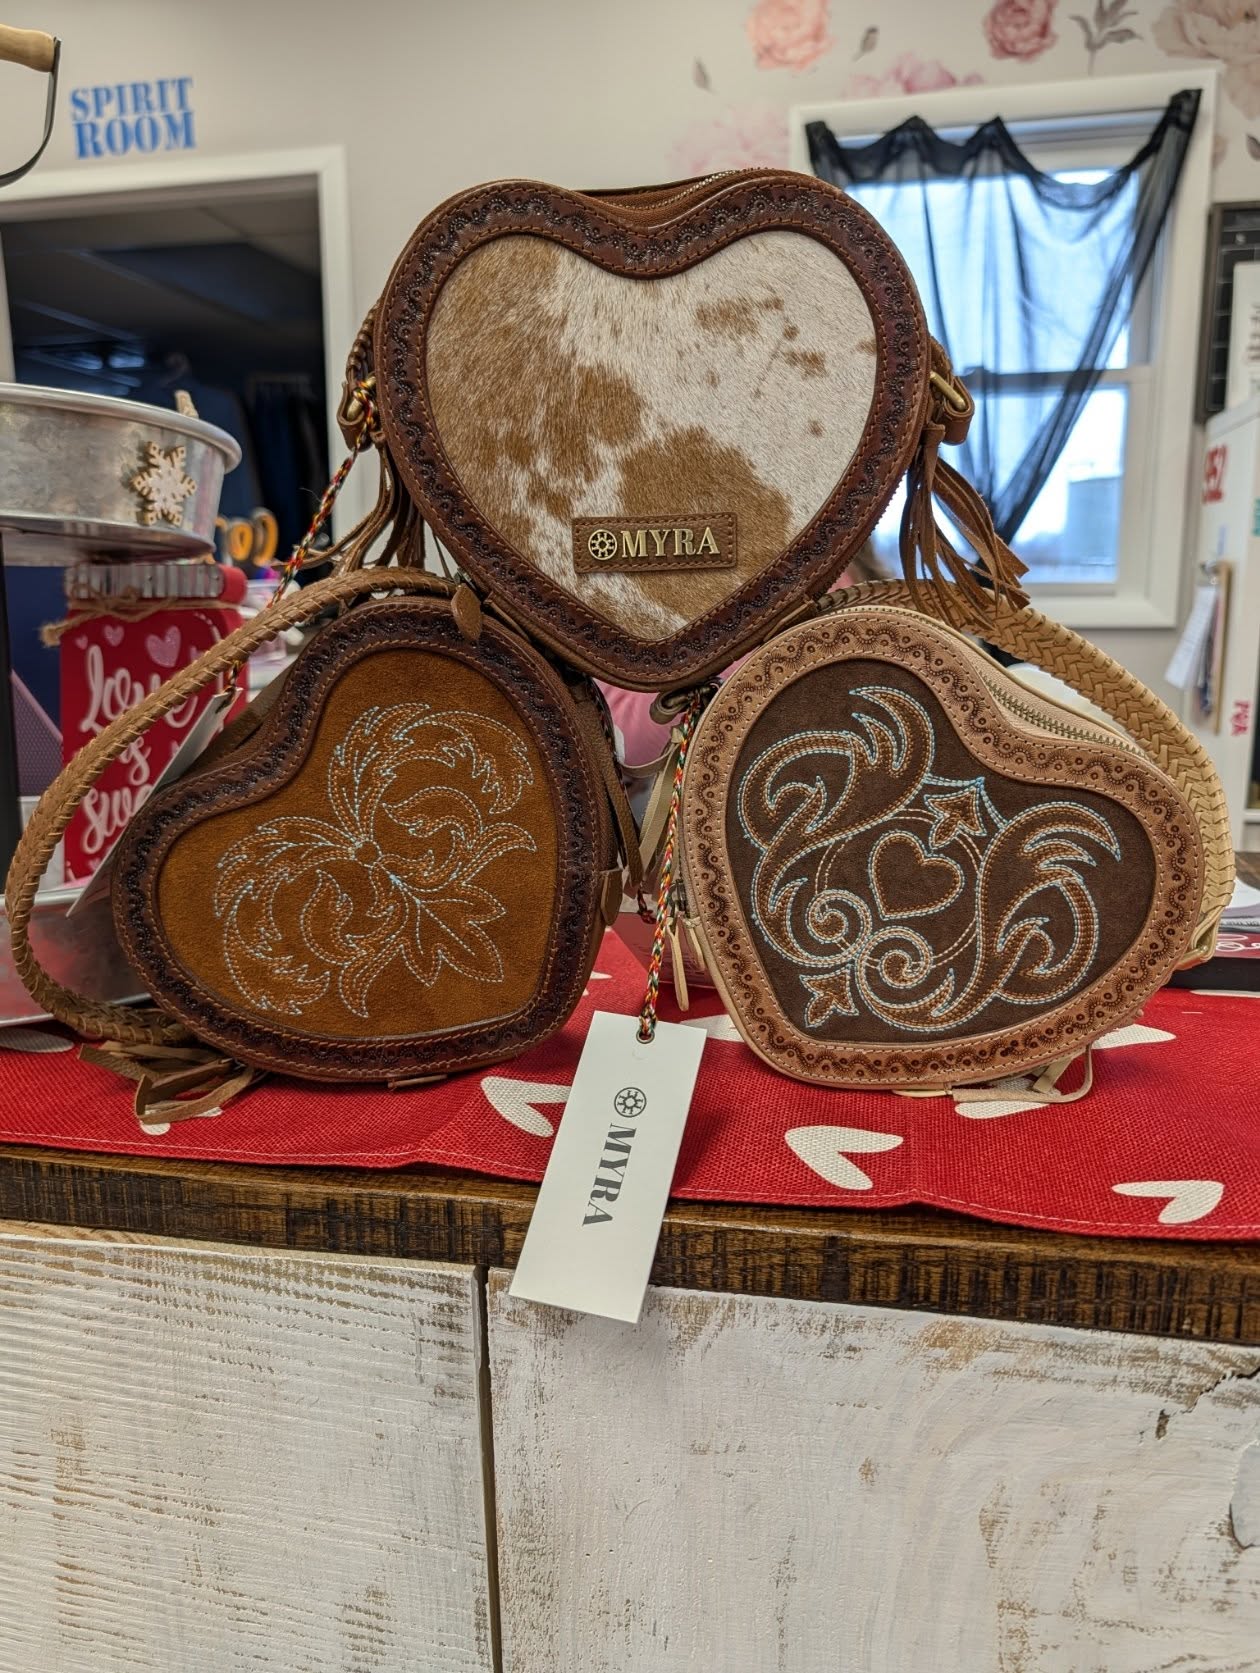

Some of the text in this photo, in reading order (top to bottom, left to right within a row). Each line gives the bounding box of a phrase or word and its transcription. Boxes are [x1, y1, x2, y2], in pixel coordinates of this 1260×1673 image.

[70, 77, 194, 121] SPIRIT
[73, 111, 197, 159] ROOM
[620, 526, 721, 558] MYRA
[582, 1122, 638, 1227] MYRA
